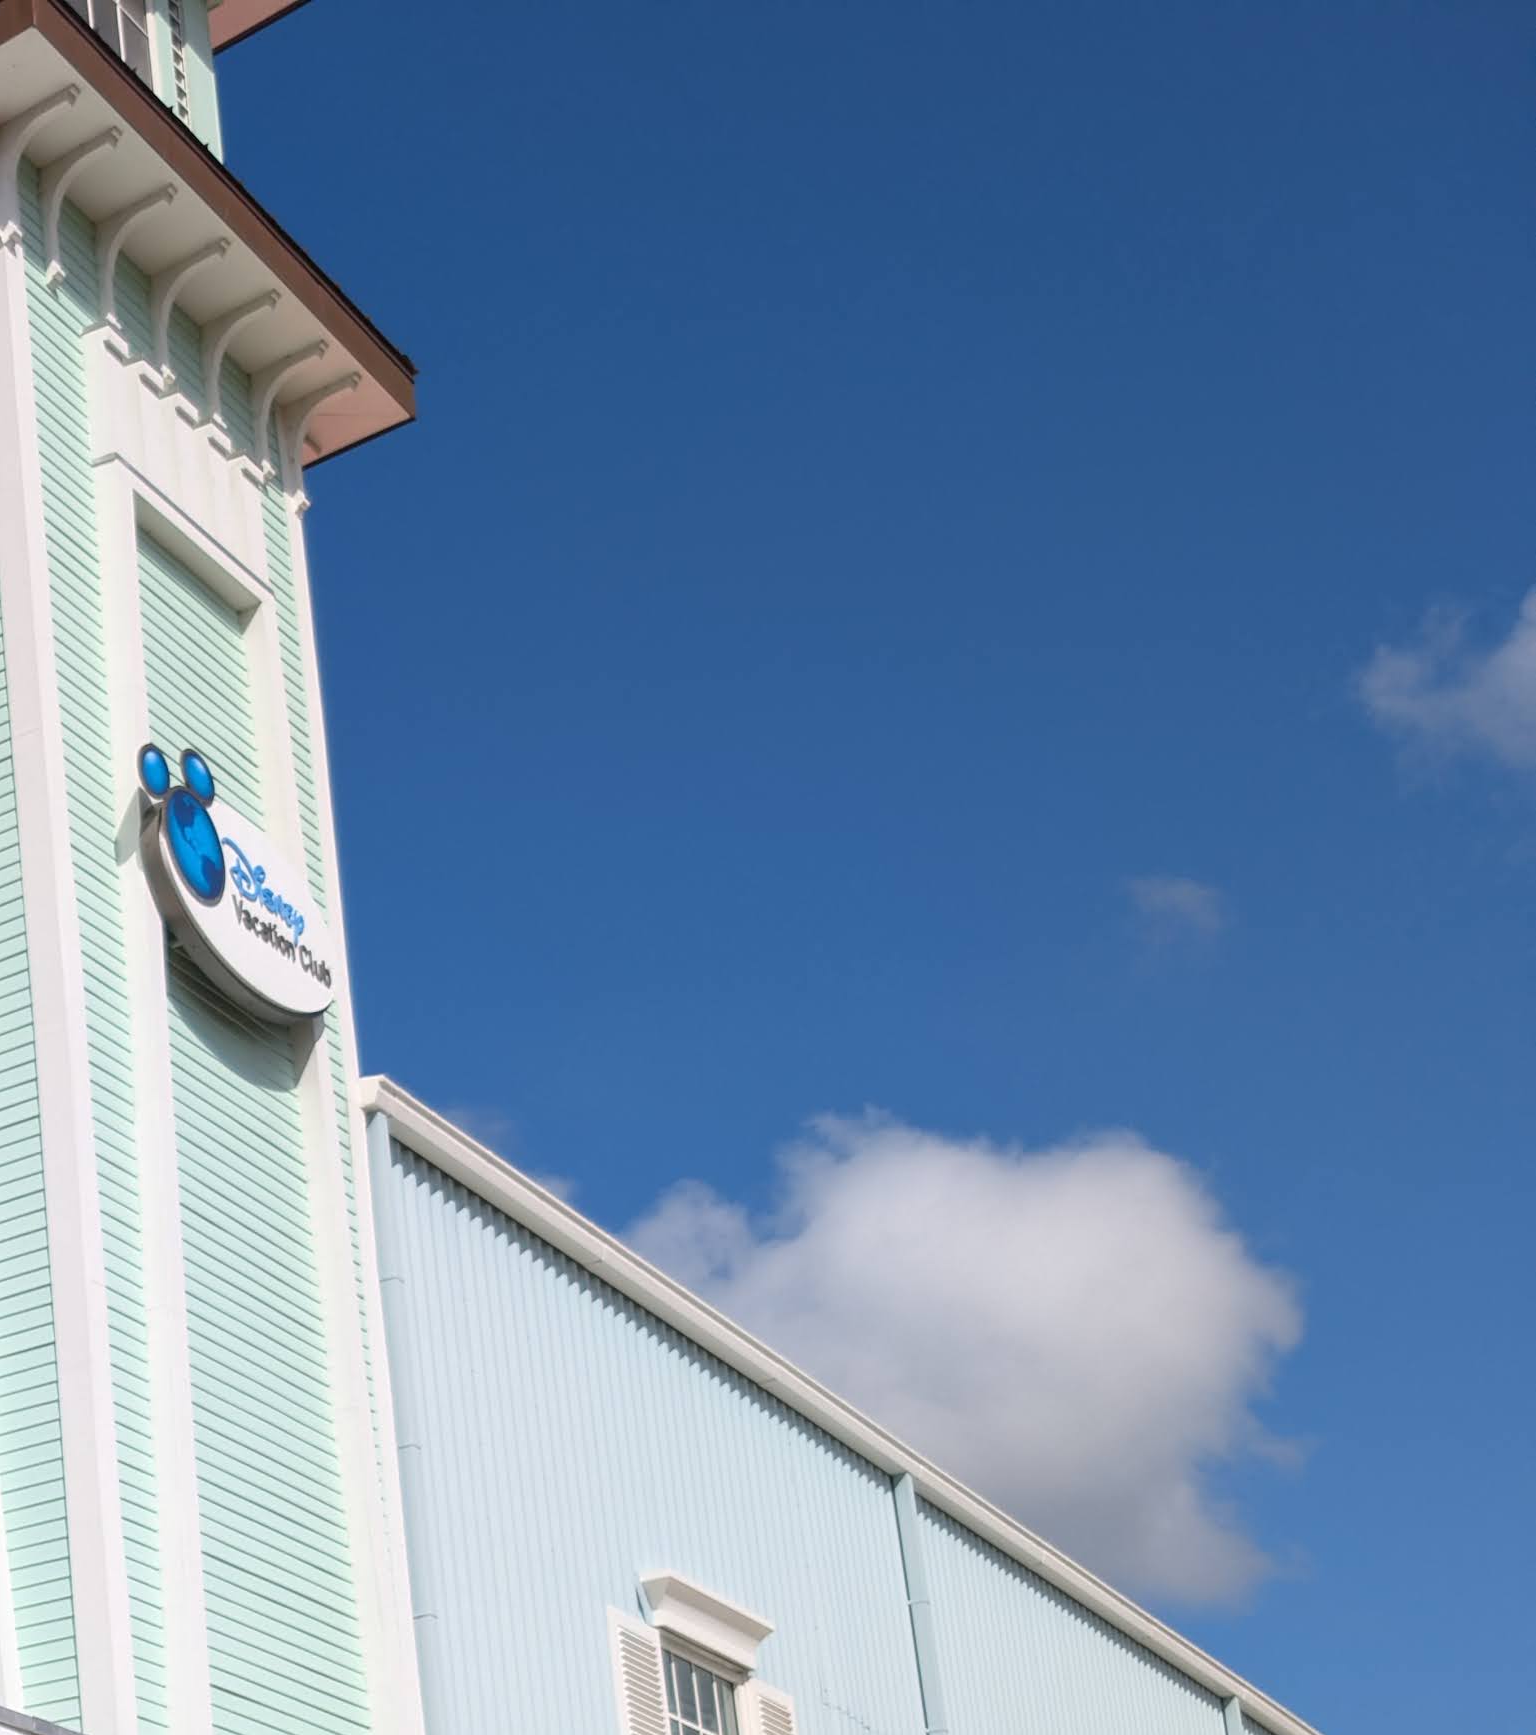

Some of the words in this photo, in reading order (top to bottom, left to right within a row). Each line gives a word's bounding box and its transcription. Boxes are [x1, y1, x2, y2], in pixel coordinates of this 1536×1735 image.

[222, 837, 305, 948] Disney
[231, 893, 297, 963] Vacation
[299, 944, 332, 990] Club
